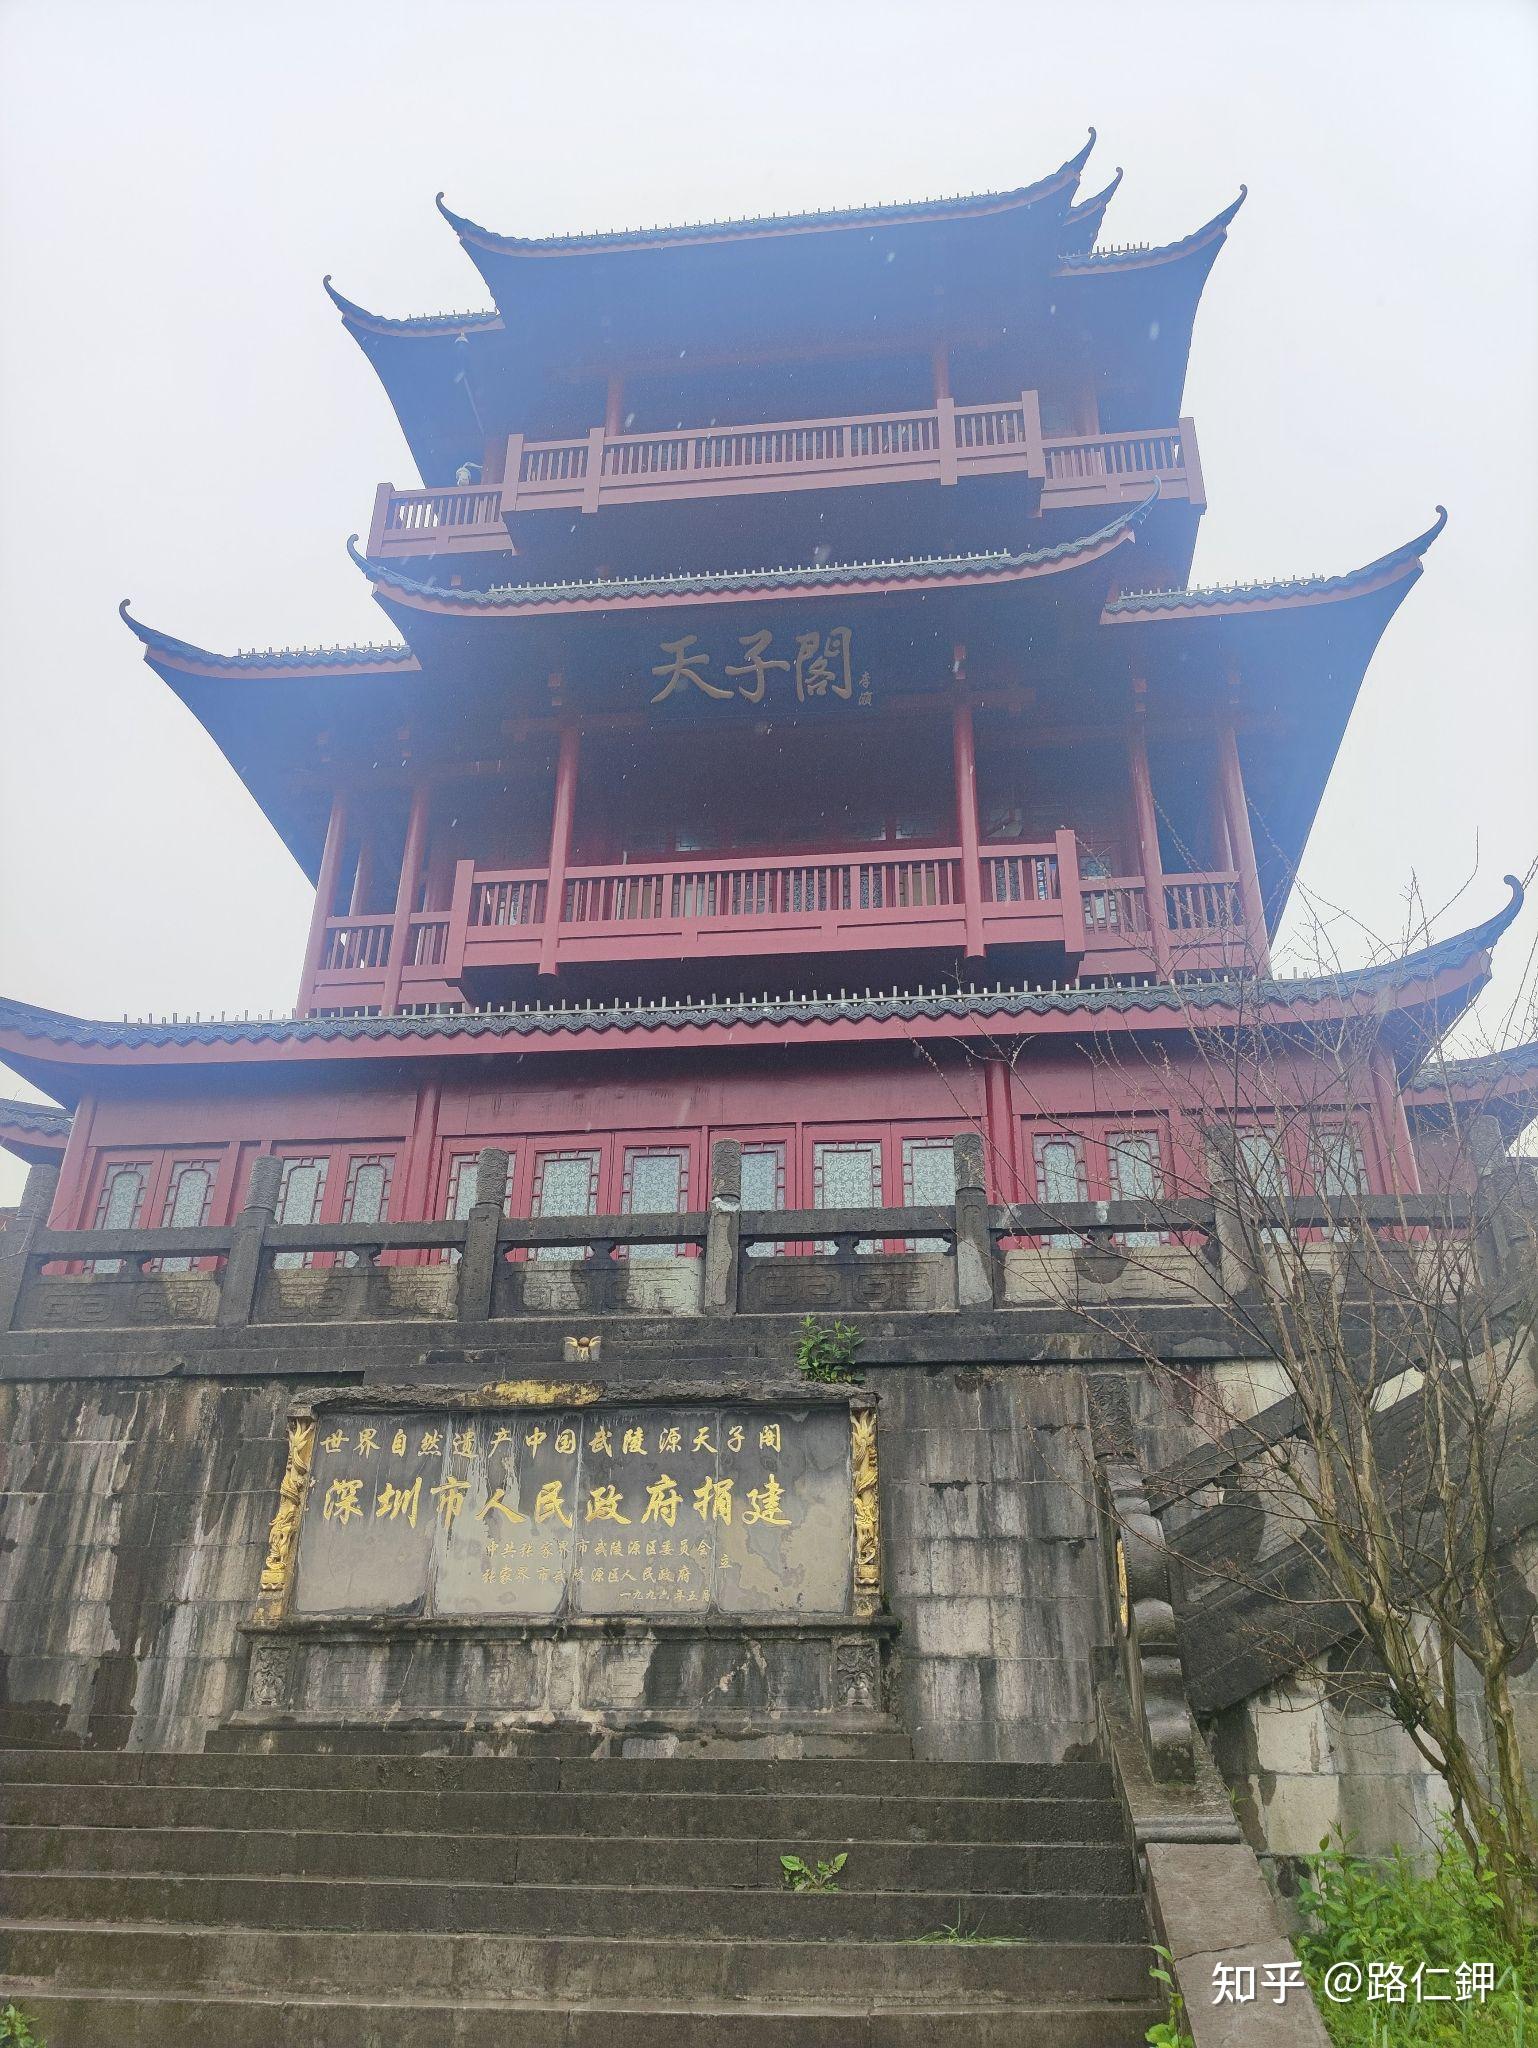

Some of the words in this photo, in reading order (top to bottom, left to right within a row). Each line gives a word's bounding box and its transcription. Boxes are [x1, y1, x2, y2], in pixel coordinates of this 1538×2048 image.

[322, 1472, 794, 1532] 深圳市人民政府捐建
[718, 1553, 733, 1570] 立
